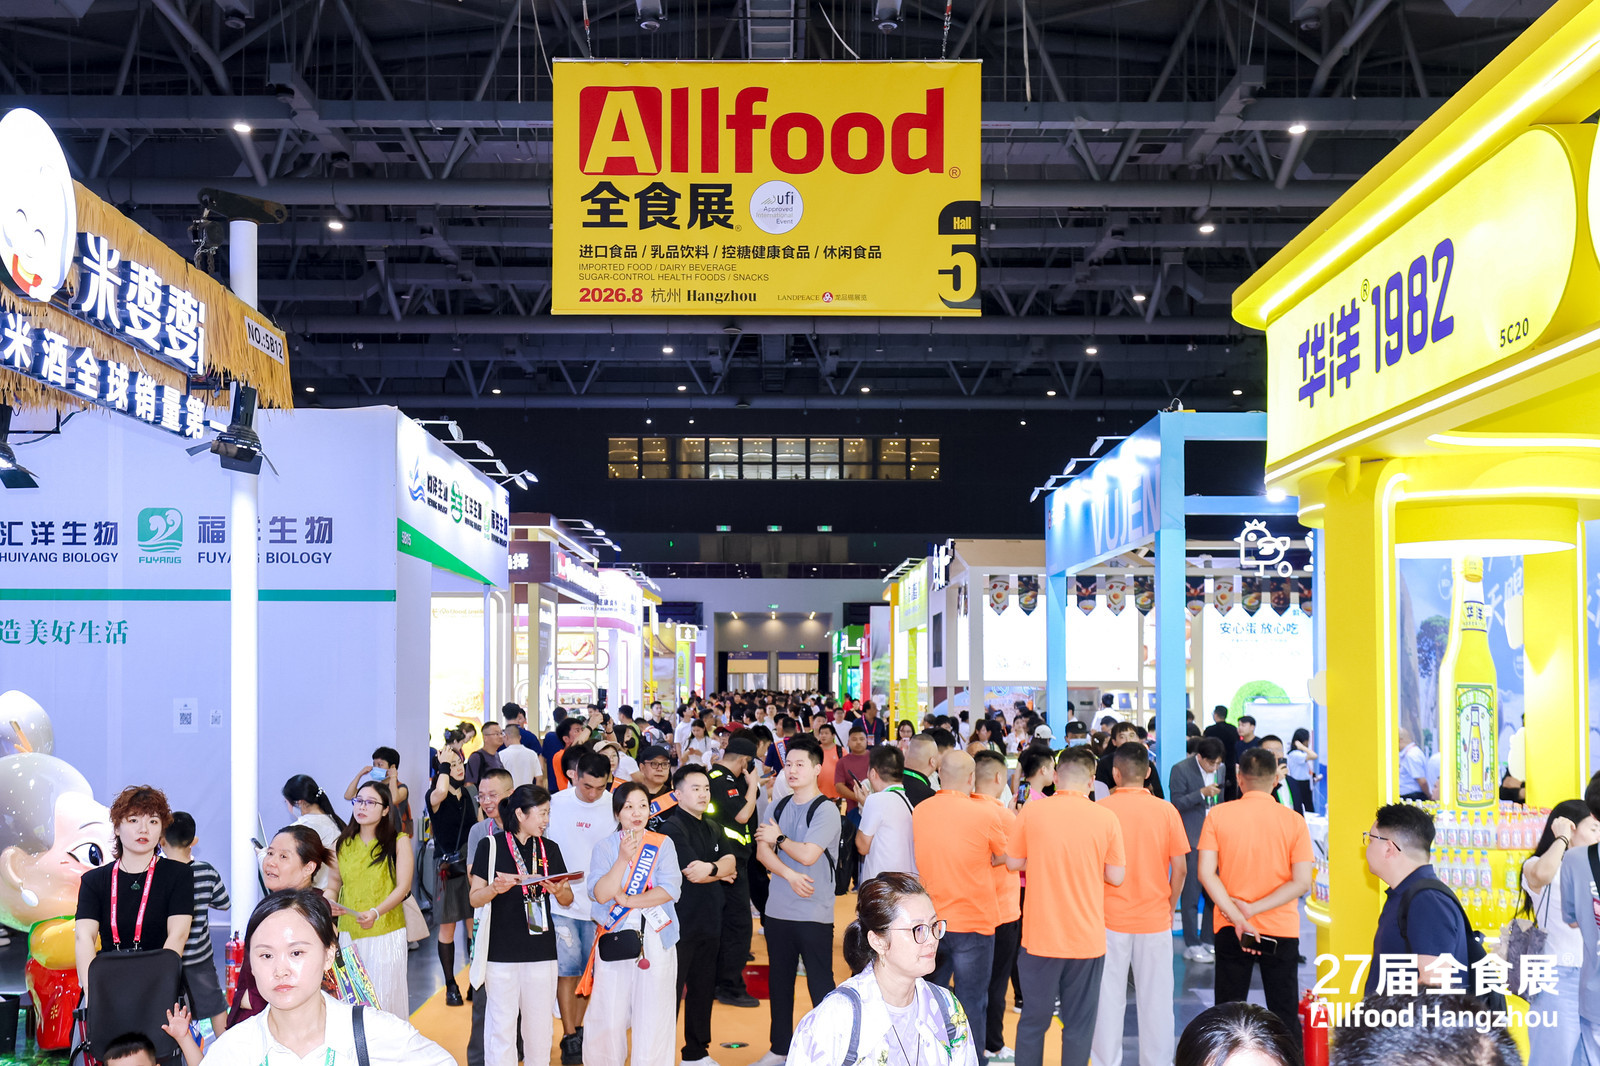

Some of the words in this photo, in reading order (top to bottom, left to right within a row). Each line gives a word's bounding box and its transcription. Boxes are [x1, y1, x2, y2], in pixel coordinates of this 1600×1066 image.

[777, 191, 794, 205] ufi
[953, 216, 972, 230] Hall
[579, 244, 638, 259] 进口食品
[650, 244, 709, 259] 乳品饮料
[721, 245, 810, 260] 控糖健康食品
[823, 245, 882, 260] 休闲食品
[578, 263, 625, 271] IMPORTED
[627, 263, 653, 271] FOOD
[659, 263, 687, 271] DAIRY
[688, 264, 737, 272] BEVERAGE
[938, 234, 977, 303] 5
[578, 273, 656, 281] SUGAR-CONTROL
[657, 273, 693, 281] HEALTH
[694, 273, 726, 281] FOODS
[733, 274, 769, 282] SNACKS
[578, 287, 644, 303] 2026.8
[650, 287, 682, 303] 杭州
[686, 289, 757, 305] Hangzhou
[1499, 317, 1530, 348] 5C20
[0, 521, 119, 546] 汇洋生物
[198, 516, 333, 544] 福生物
[62, 552, 119, 563] BIOLOGY
[138, 556, 182, 564] FUYANG
[266, 551, 332, 564] BIOLOGY
[0, 618, 128, 645] 造美好生活
